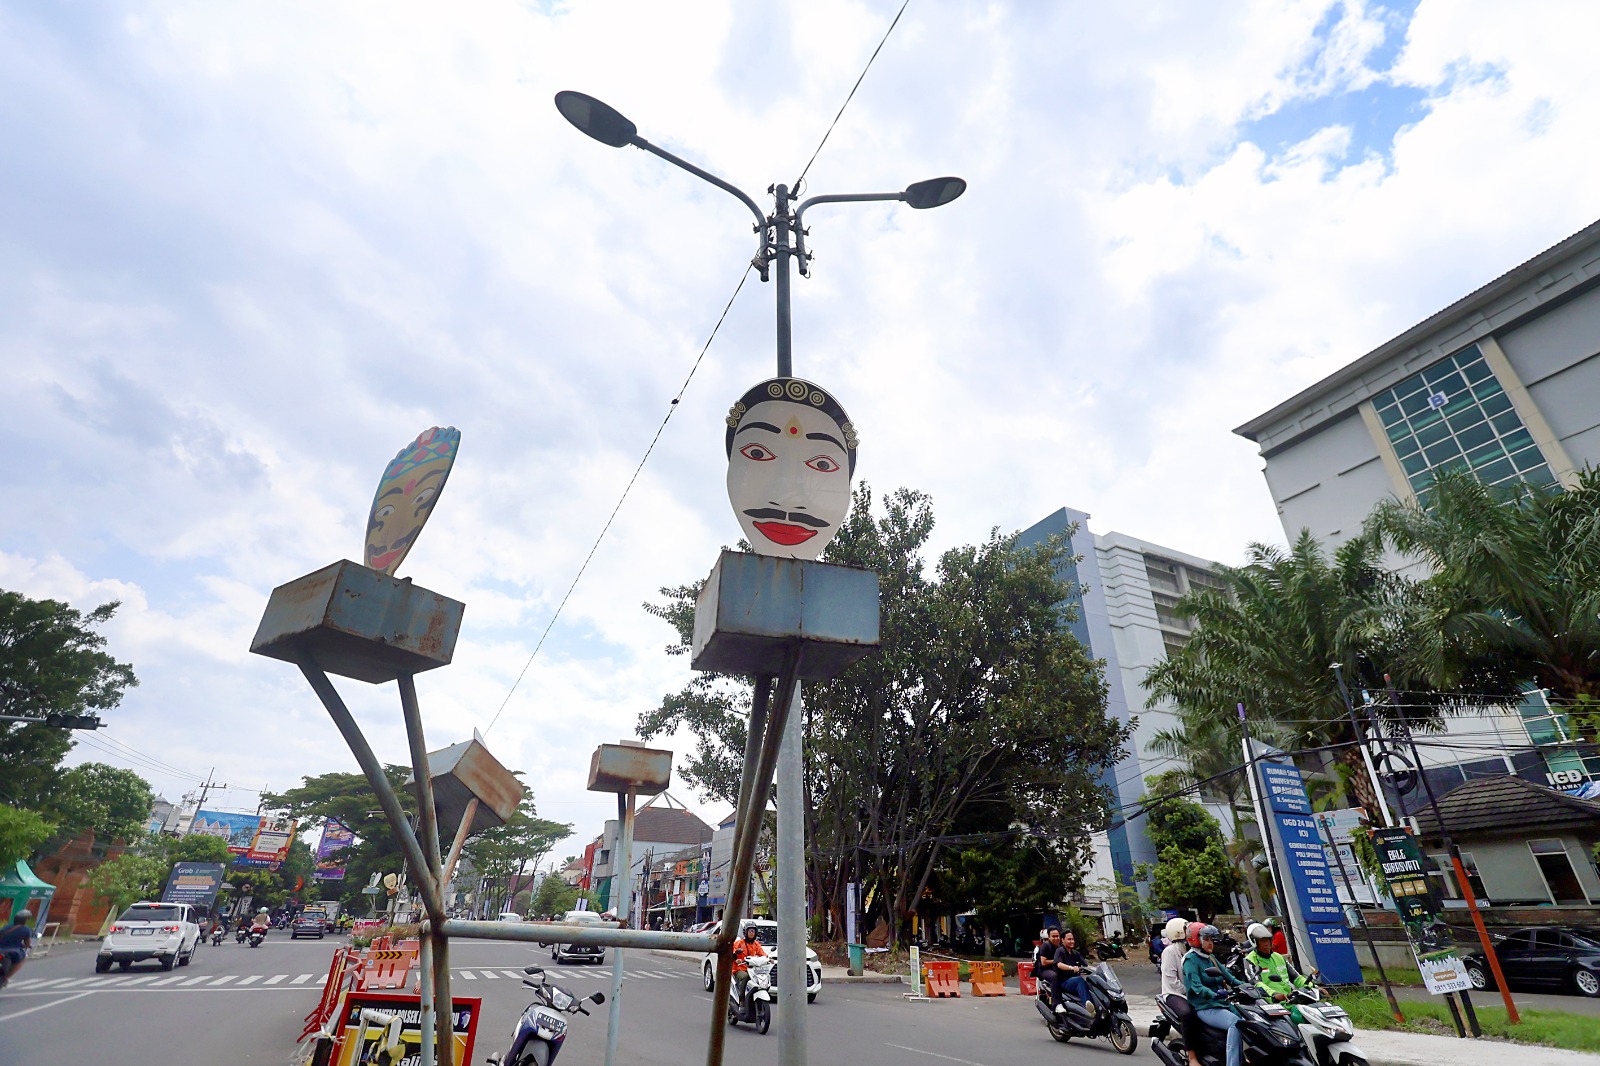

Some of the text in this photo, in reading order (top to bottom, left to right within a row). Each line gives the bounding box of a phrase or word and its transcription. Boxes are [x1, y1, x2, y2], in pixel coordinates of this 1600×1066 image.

[1430, 394, 1445, 408] B
[1545, 770, 1582, 785] IGD
[1282, 818, 1296, 826] UGD
